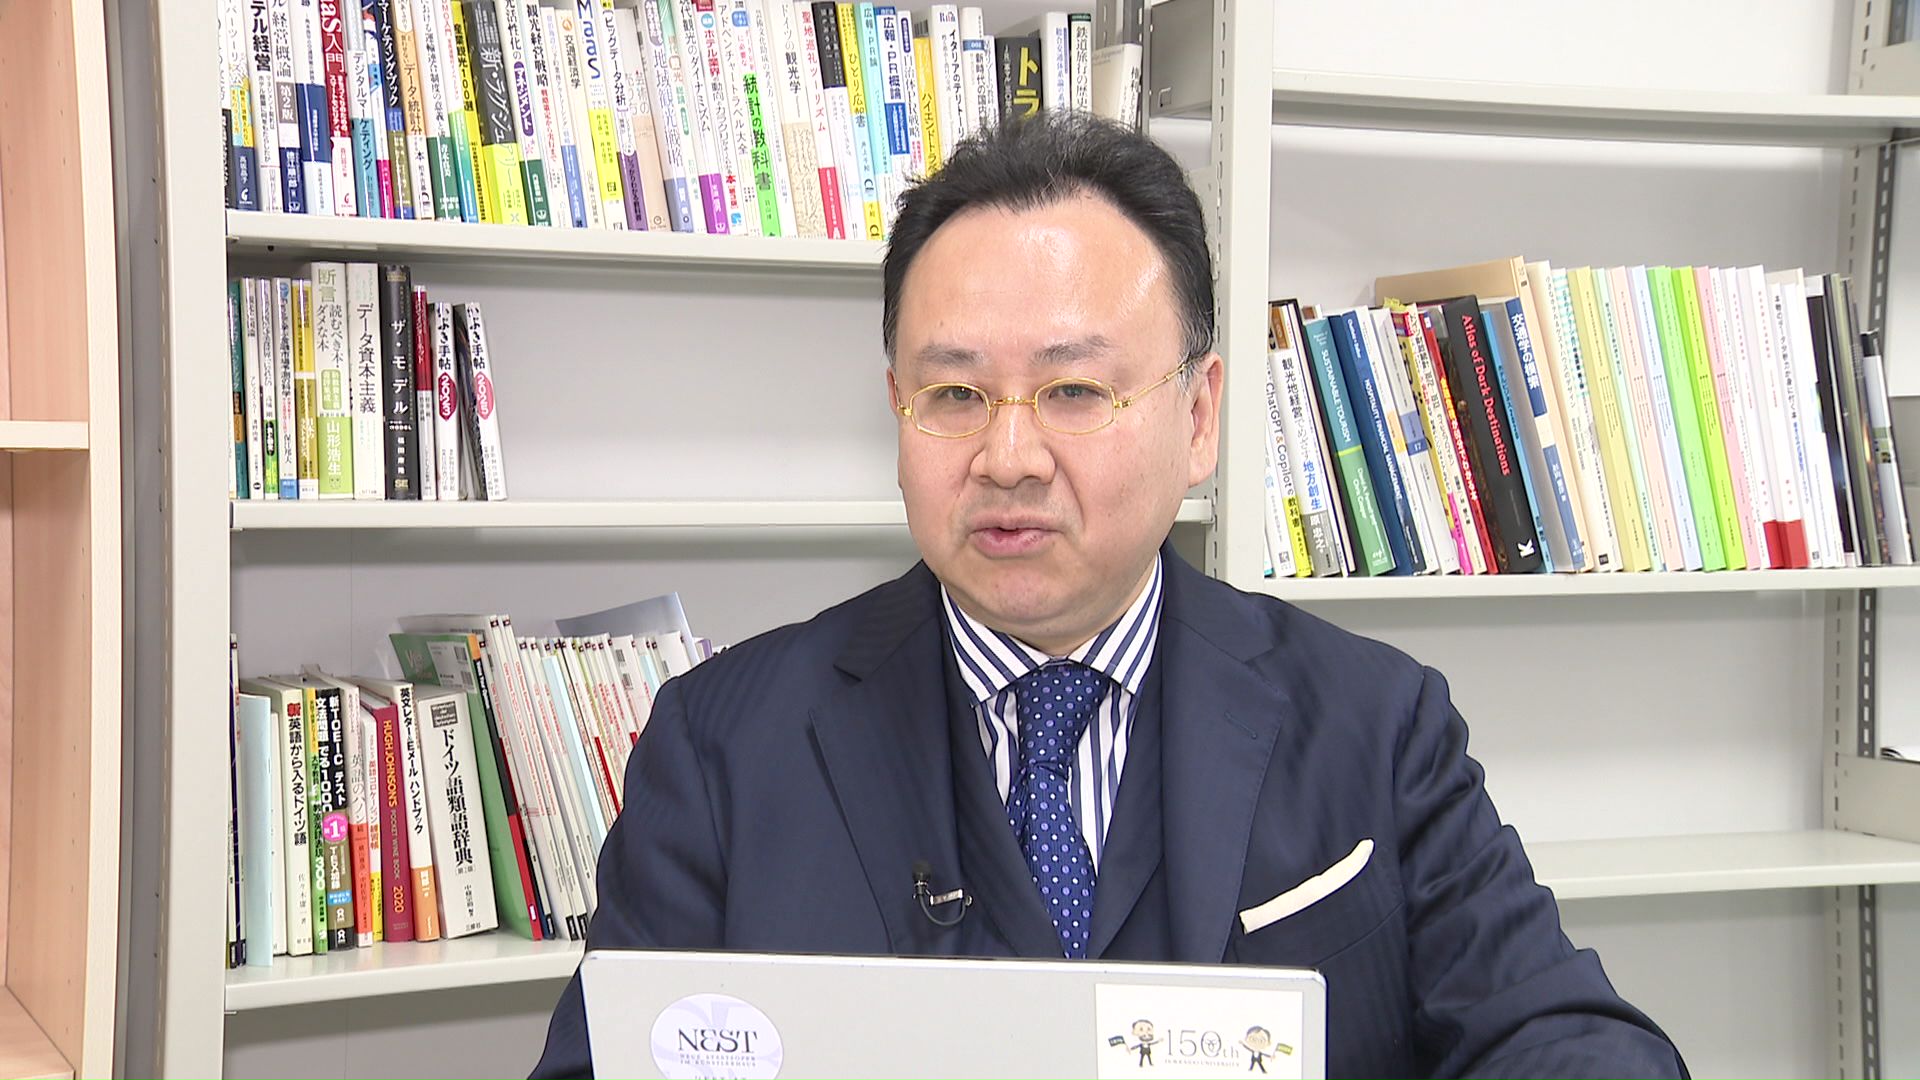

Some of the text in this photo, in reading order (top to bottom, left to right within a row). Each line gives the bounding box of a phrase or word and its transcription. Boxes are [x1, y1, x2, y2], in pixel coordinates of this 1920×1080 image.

[251, 0, 271, 72] テル経営
[320, 0, 345, 73] aS入門
[527, 4, 548, 87] 観光経営戦略
[564, 34, 581, 90] 交通経済学
[576, 0, 600, 80] MaaS
[782, 4, 801, 94] ドイツの観光学
[802, 11, 827, 132] 聖地巡礼ツーリズム
[864, 8, 878, 67] 広報・PR論
[883, 16, 902, 100] 広報・PR概論
[1075, 26, 1088, 110] 鉄道旅行の歴史
[352, 52, 373, 171] デジタルマーケティング
[718, 5, 747, 155] アドベンチャートラベル大全
[743, 74, 771, 191] 統計の教科書
[318, 268, 337, 303] 断言
[317, 304, 330, 352] ダメな本
[356, 302, 377, 414] データ資本主義
[391, 319, 409, 415] ザ・モデル
[437, 307, 452, 416] かぶき手帖 2023
[466, 306, 489, 415] かぶき手帖 2025
[1461, 314, 1477, 349] Atlas
[1471, 349, 1484, 364] of
[1265, 382, 1284, 435] ChatGPT
[1275, 436, 1284, 444] &
[1321, 349, 1352, 443] SUSTAINABLE TOURISM
[1475, 365, 1492, 397] Dark
[326, 420, 342, 477] 山形浩生
[1281, 357, 1322, 511] 観光地経営でめざす地方創生
[1364, 378, 1404, 500] HOSPITALITY FINANCIAL MANAGEMENT
[1484, 396, 1512, 476] Destinations
[315, 697, 330, 743] 文法問題
[329, 695, 347, 806] 新TOEIC テスト
[286, 702, 307, 846] 新英語から入るドイツ語
[410, 781, 424, 835] ハンドブック
[442, 728, 473, 867] ドイツ語類語辞典
[383, 719, 394, 750] HUGH
[393, 885, 404, 913] 2020
[678, 1028, 758, 1053] NEST
[1167, 1029, 1240, 1059] 150th
